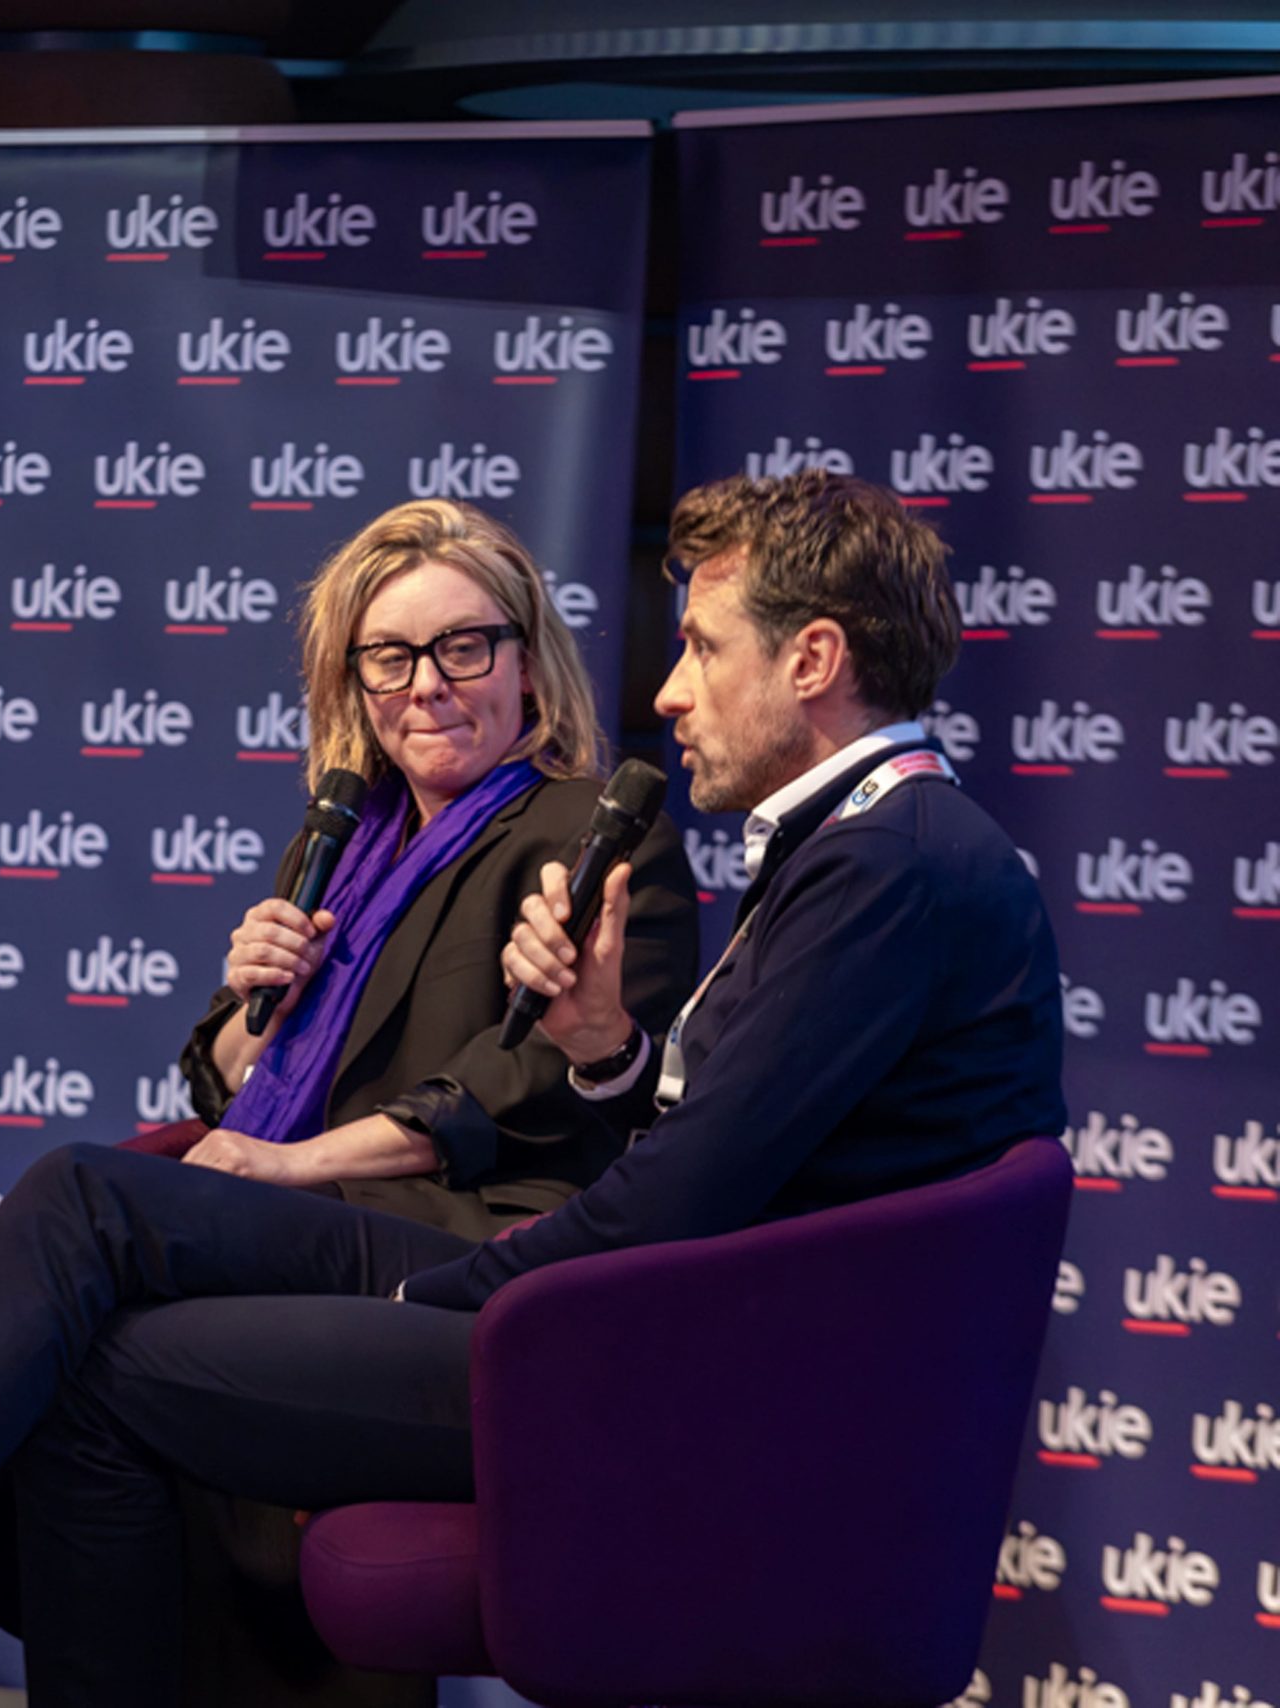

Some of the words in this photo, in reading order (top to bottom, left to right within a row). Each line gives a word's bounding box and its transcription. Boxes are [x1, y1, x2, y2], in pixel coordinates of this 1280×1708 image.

[107, 195, 217, 248] ukie
[264, 193, 375, 247] ukie
[423, 191, 537, 245] ukie
[762, 175, 864, 233] ukie
[906, 168, 1008, 226] ukie
[1051, 160, 1158, 219] ukie
[1201, 153, 1280, 213] uki
[25, 319, 133, 372] ukie
[178, 318, 290, 372] ukie
[337, 318, 450, 372] ukie
[495, 316, 611, 371] ukie
[689, 308, 786, 366] ukie
[826, 304, 931, 362] ukie
[969, 298, 1075, 356] ukie
[1117, 292, 1228, 352] ukie
[95, 442, 205, 496] ukie
[251, 443, 363, 497] ukie
[409, 443, 519, 497] ukie
[891, 434, 992, 493] ukie
[1031, 430, 1142, 489] ukie
[12, 564, 120, 619] ukie
[166, 567, 277, 622] ukie
[1097, 565, 1210, 625] ukie
[82, 689, 192, 745] ukie
[237, 692, 308, 748] uki
[924, 701, 980, 761] ie
[1013, 701, 1123, 762] ukie
[1166, 703, 1280, 764] ukie
[152, 815, 263, 872] ukie
[685, 829, 750, 889] kie
[1078, 838, 1191, 901] ukie
[68, 936, 178, 995] ukie
[1146, 978, 1260, 1043] ukie
[137, 1064, 198, 1122] uk
[1214, 1120, 1280, 1187] uk
[1125, 1255, 1240, 1323] ukie
[1040, 1388, 1151, 1457] ukie
[1193, 1400, 1280, 1470] uki
[1103, 1533, 1218, 1604] ukie
